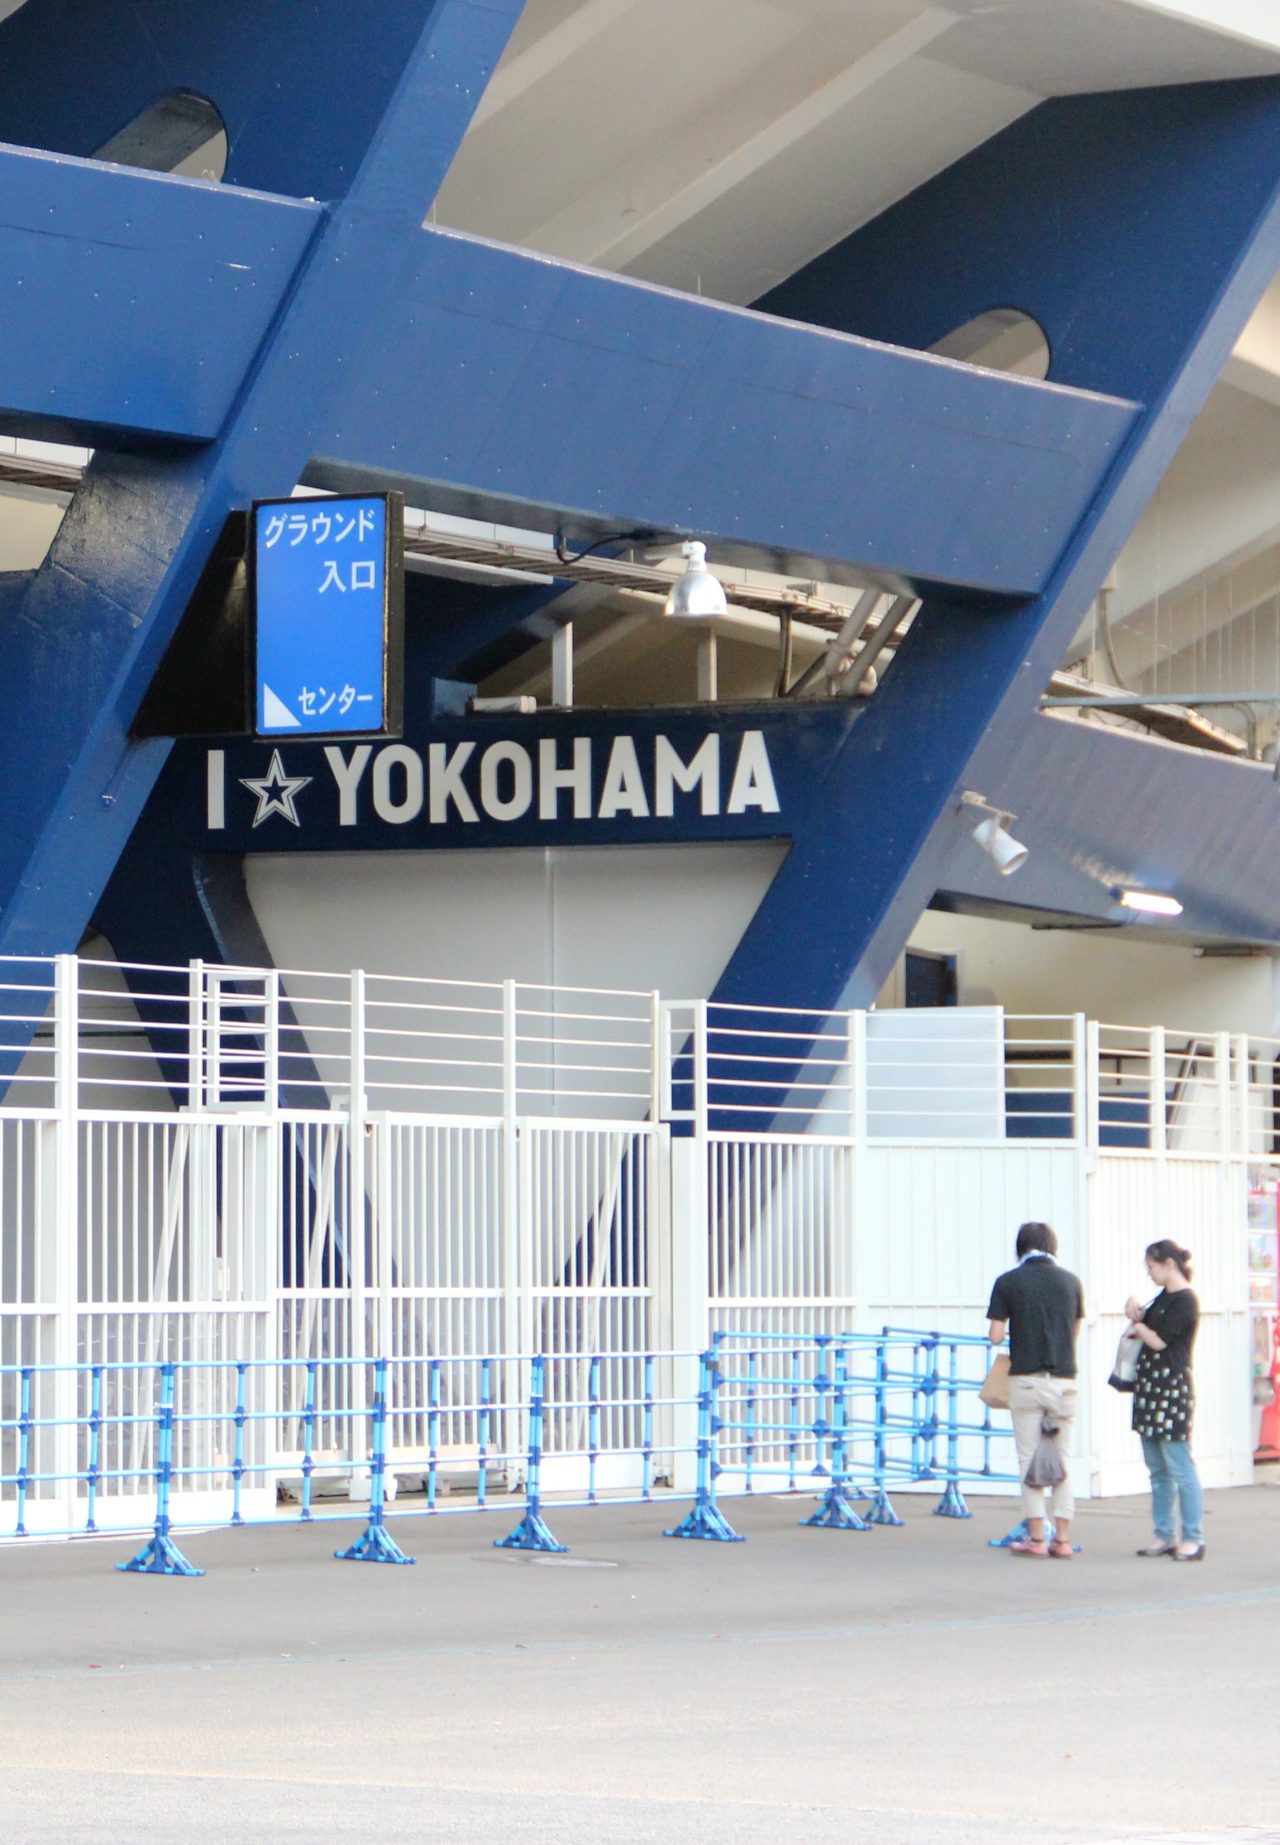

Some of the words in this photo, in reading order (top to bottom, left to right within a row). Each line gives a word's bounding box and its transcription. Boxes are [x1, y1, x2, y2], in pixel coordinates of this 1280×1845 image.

[264, 509, 375, 549] グラウンド
[318, 560, 376, 593] 入口
[298, 684, 373, 716] センター
[207, 749, 226, 830] I
[323, 730, 782, 827] YOKOHAMA
